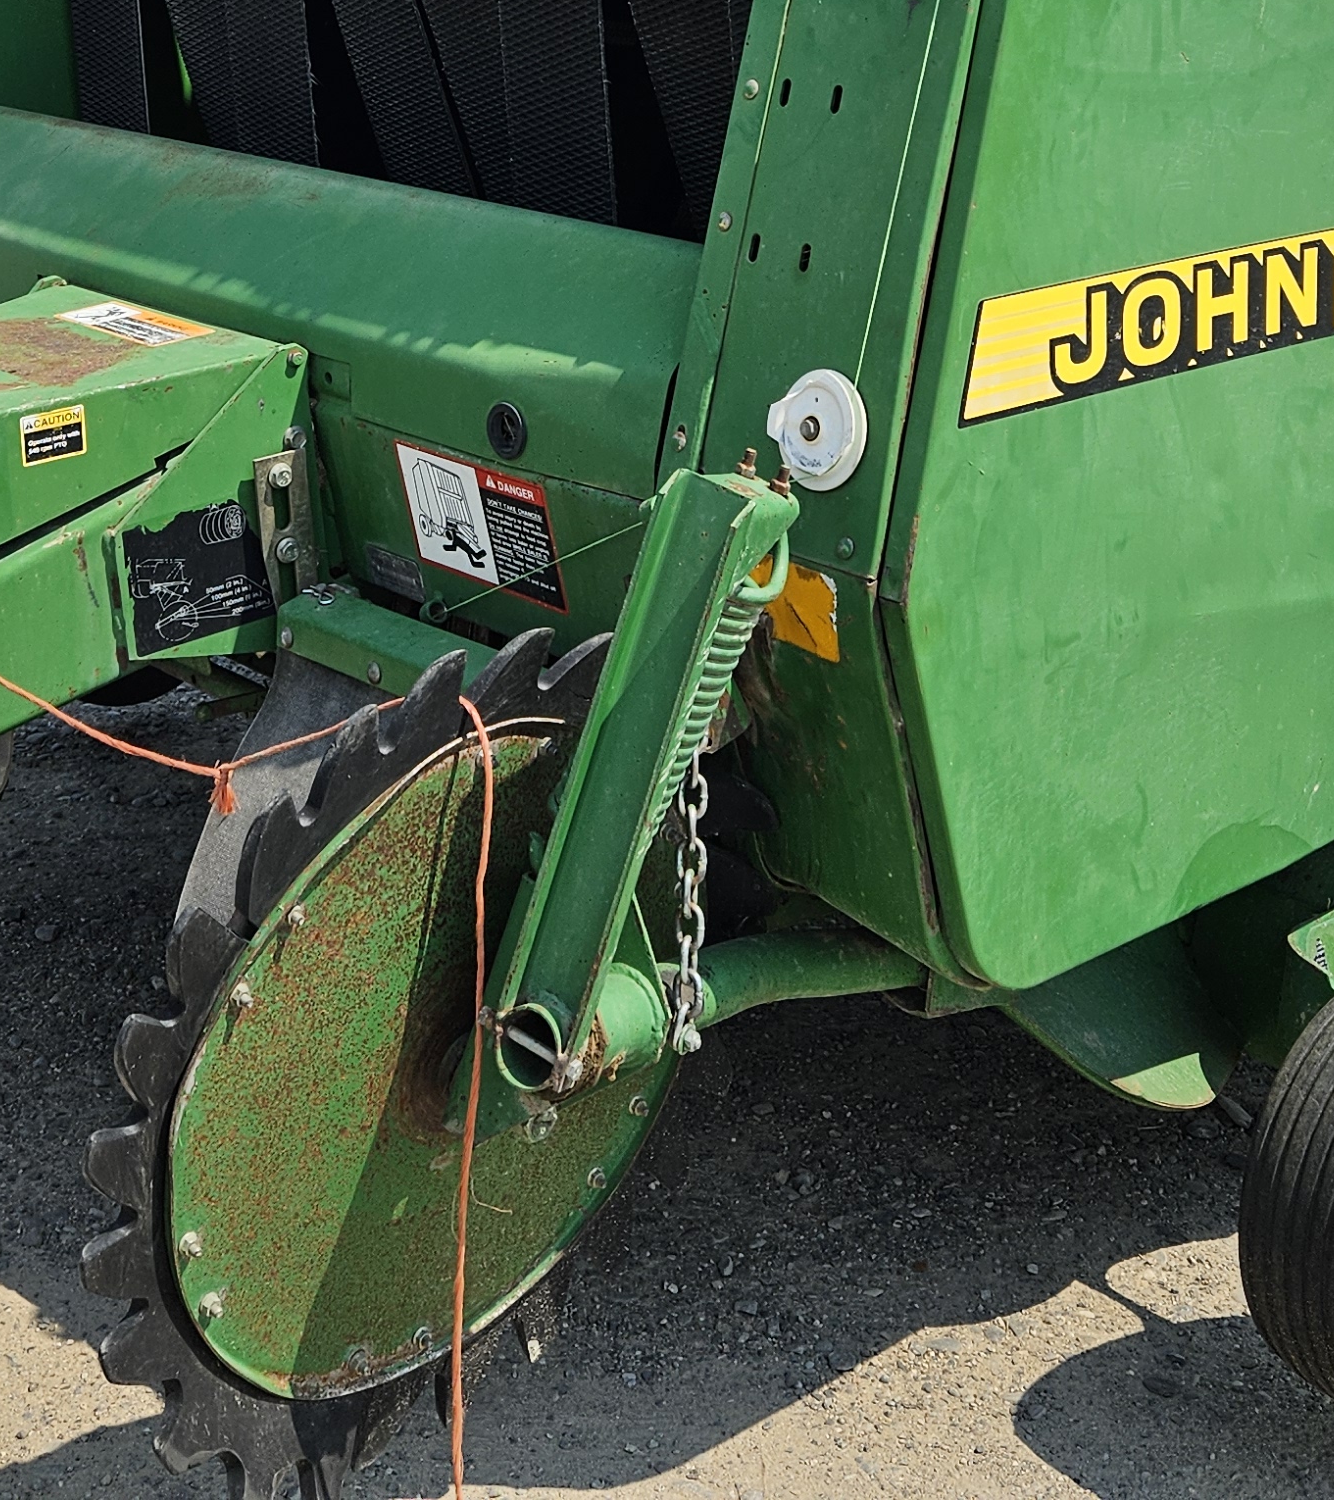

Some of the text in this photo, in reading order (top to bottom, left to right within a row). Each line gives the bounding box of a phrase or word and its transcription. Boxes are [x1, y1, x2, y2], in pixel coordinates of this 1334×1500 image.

[1052, 244, 1323, 386] JOHN
[34, 412, 80, 428] CAUTION
[28, 430, 80, 447] Operate only with
[40, 445, 53, 453] rpm
[53, 441, 67, 449] PTO
[496, 480, 535, 501] DANGER
[182, 586, 189, 594] A
[205, 584, 224, 594] 50mm
[211, 590, 233, 601] 100mm
[234, 587, 240, 595] (4
[222, 597, 244, 607] 150mm
[231, 604, 254, 615] 200mm
